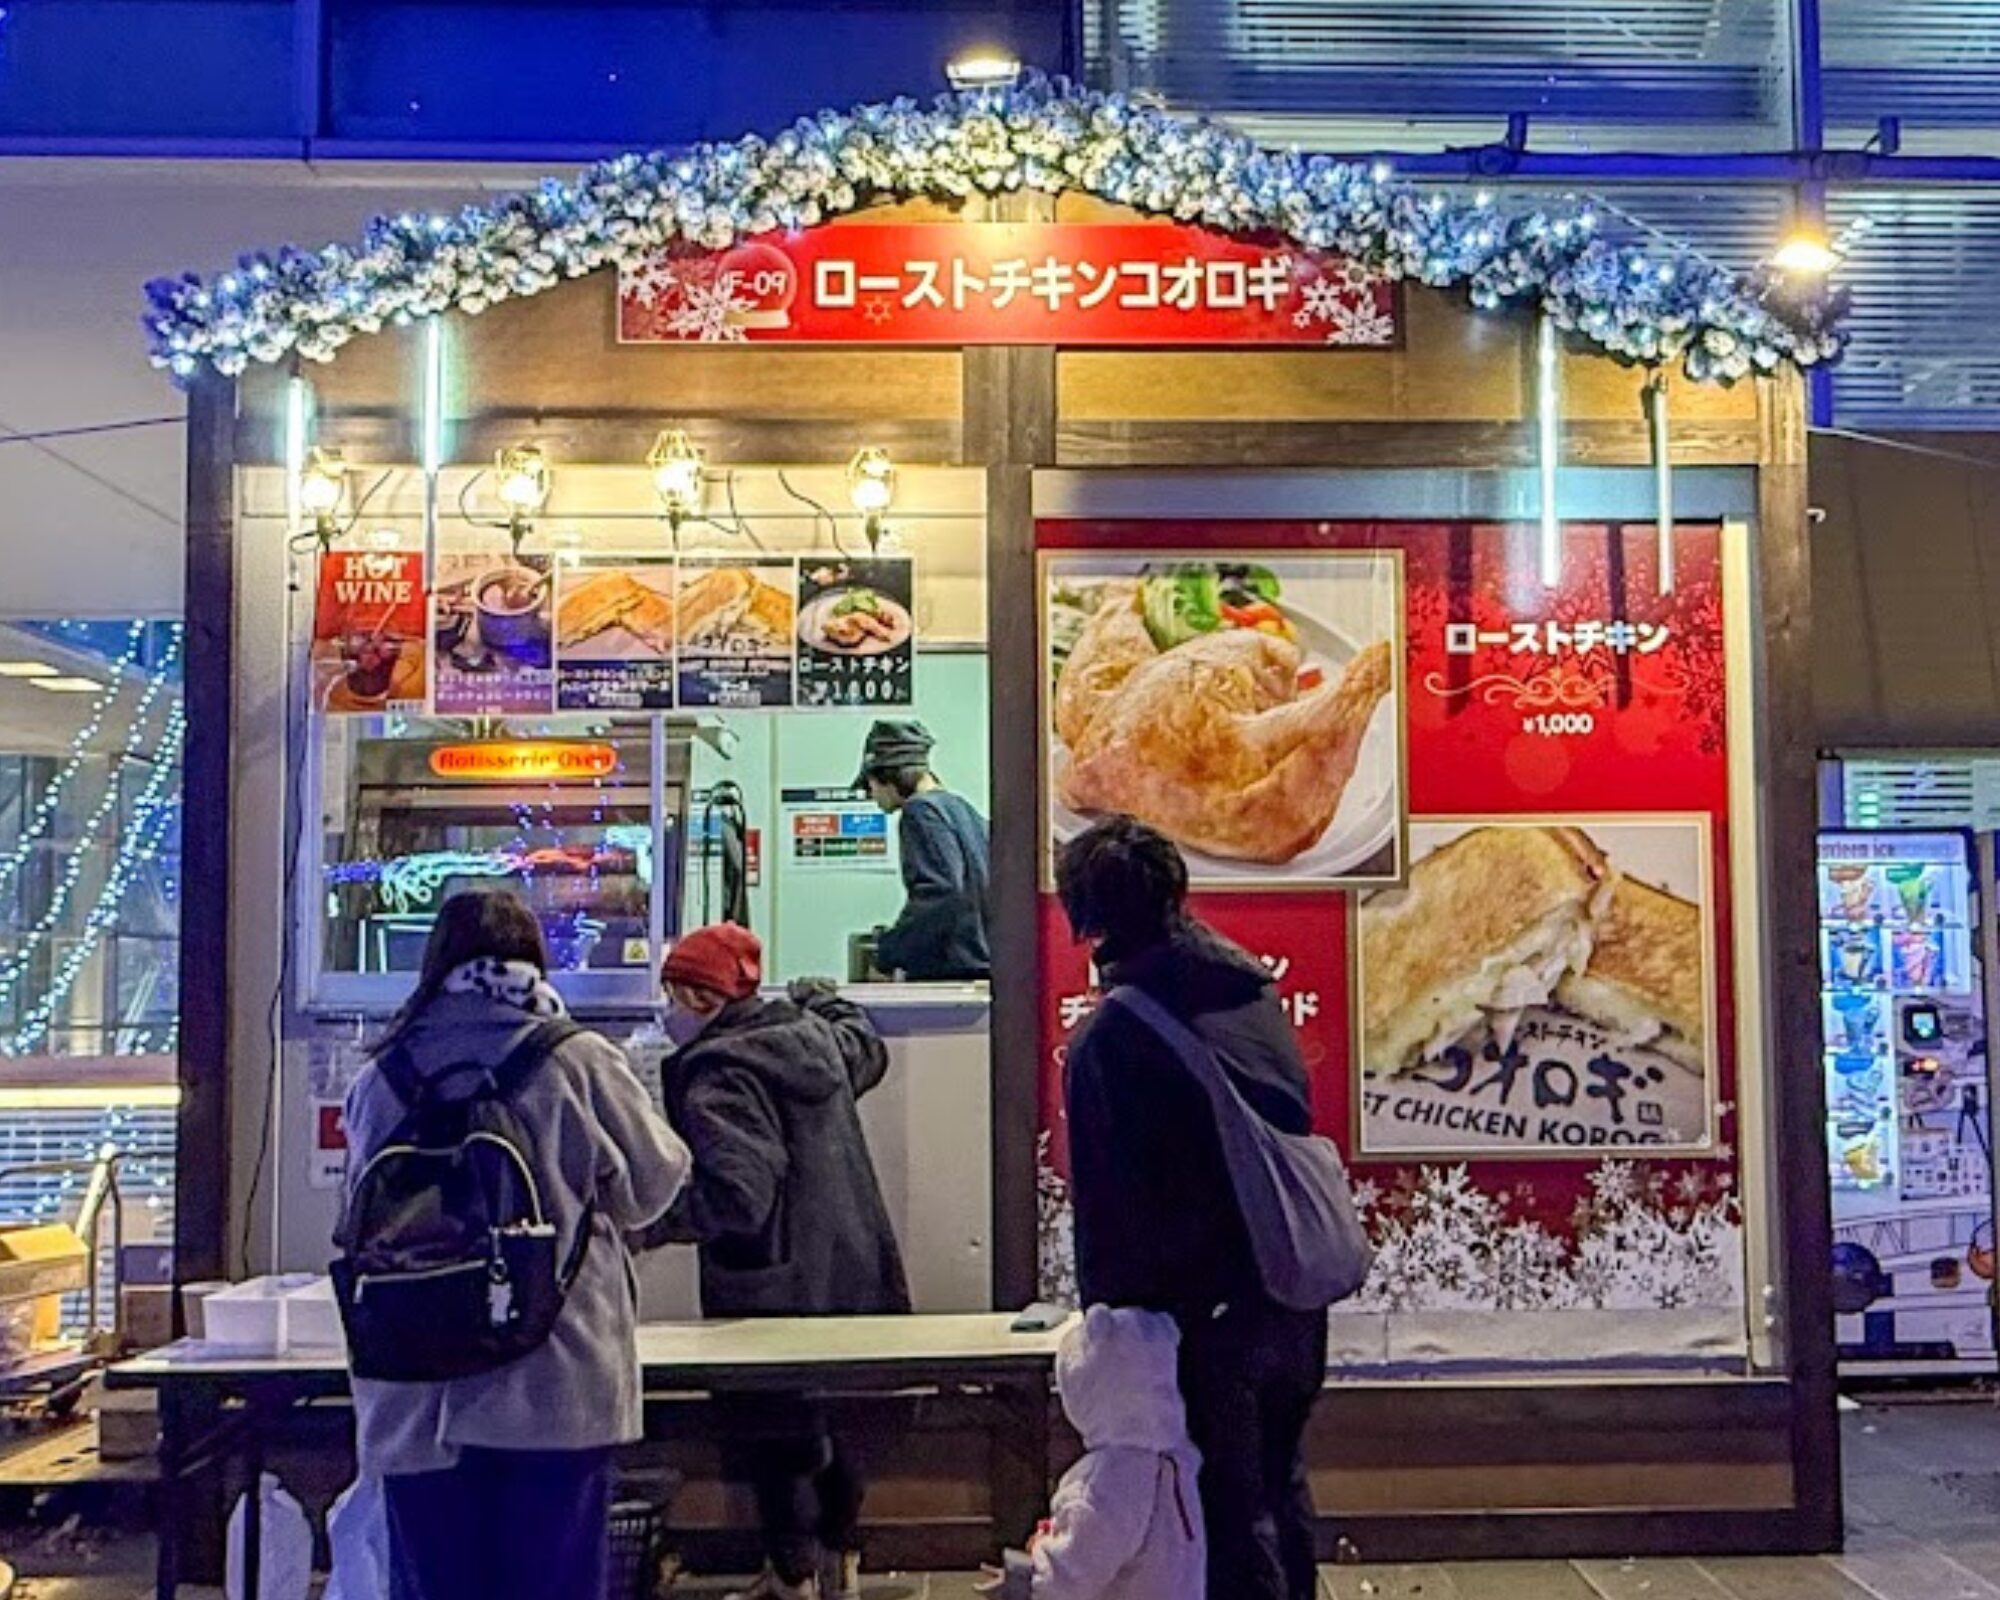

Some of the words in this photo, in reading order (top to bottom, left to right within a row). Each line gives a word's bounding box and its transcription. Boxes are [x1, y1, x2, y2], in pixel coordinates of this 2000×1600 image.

[815, 255, 1292, 311] ローストチキンコオロギ
[335, 580, 413, 604] WINE
[1446, 621, 1669, 655] ローストチキン
[798, 655, 909, 675] ローストチキン
[1522, 713, 1594, 737] ¥1,000
[439, 751, 550, 769] Rotisserie
[1393, 1097, 1528, 1139] CHICKEN
